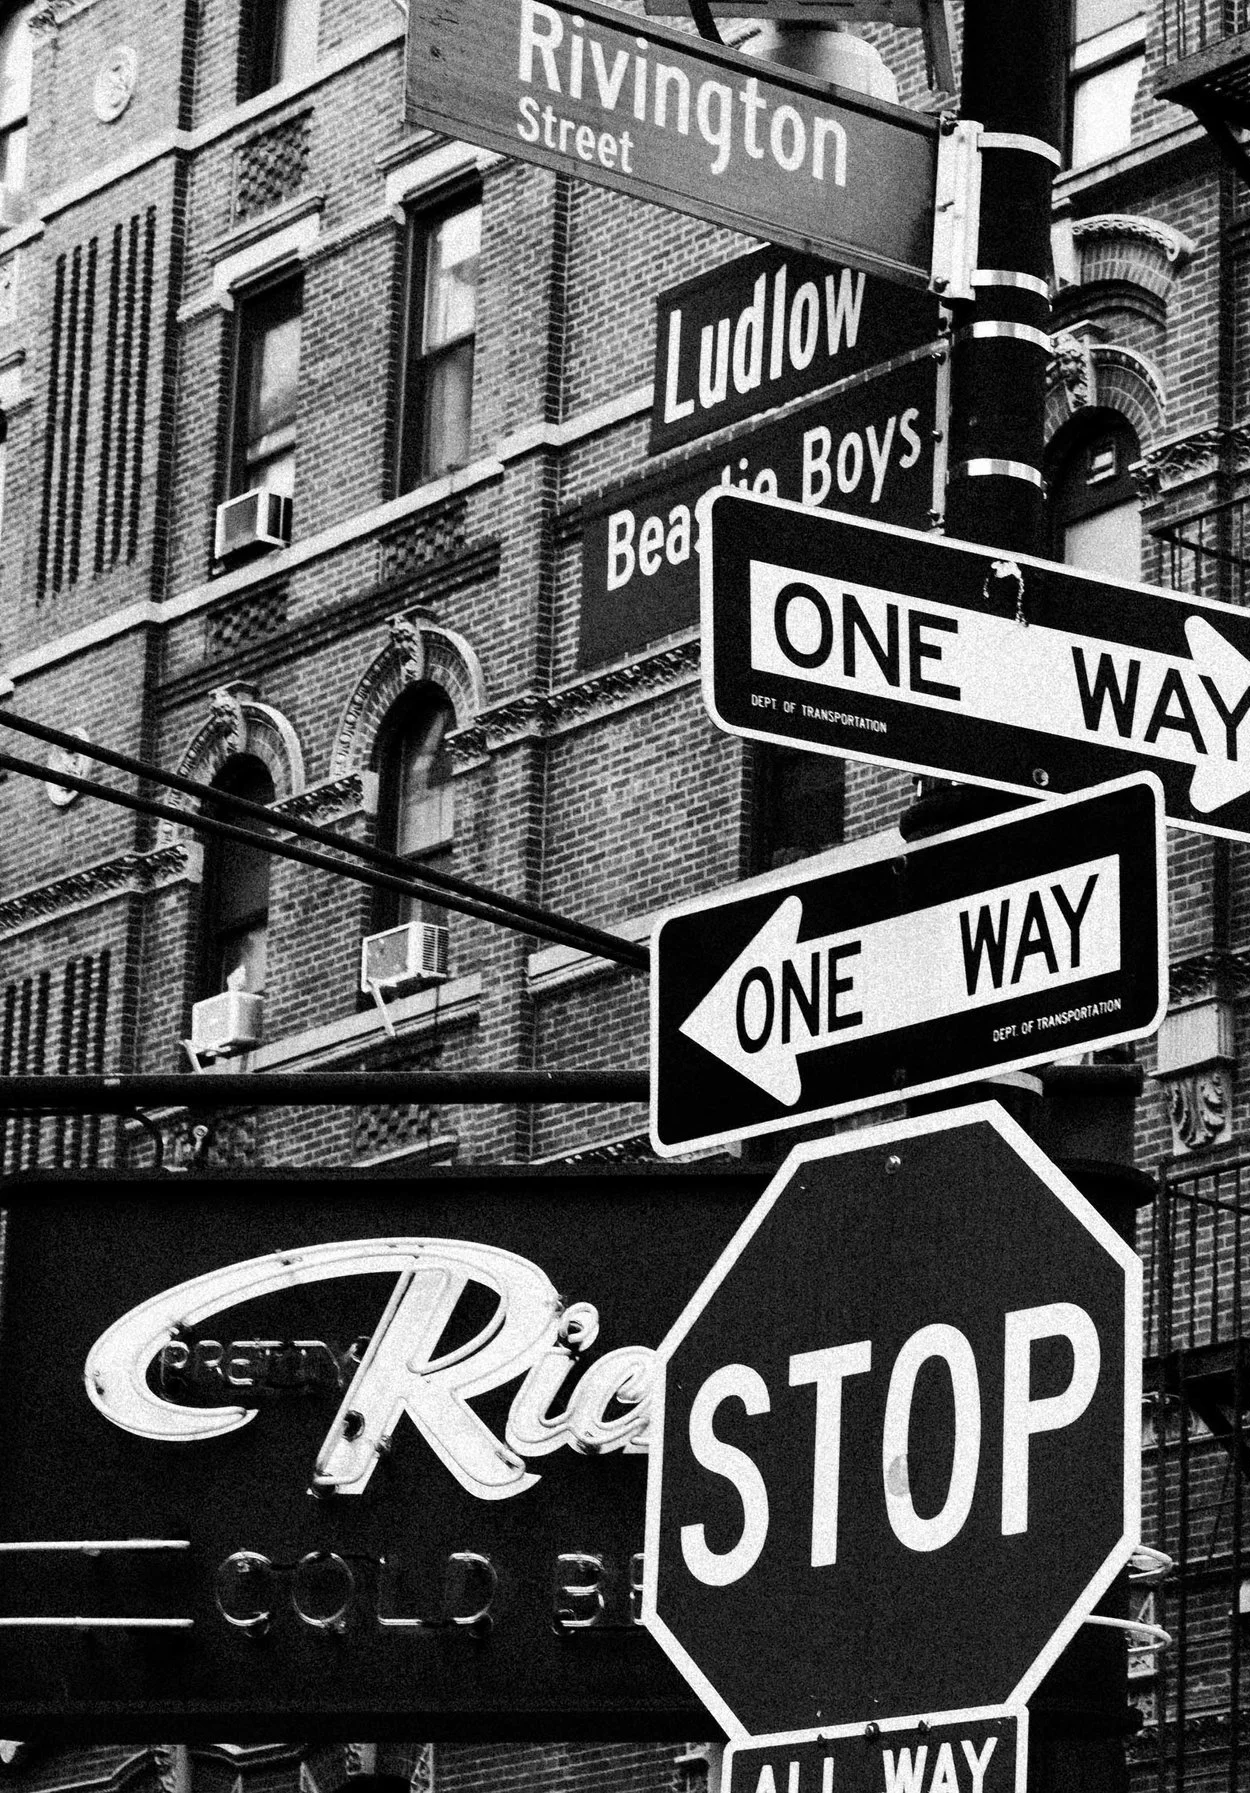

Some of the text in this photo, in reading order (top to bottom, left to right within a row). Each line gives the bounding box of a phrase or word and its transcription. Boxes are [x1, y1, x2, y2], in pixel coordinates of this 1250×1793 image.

[517, 97, 634, 174] Street
[518, 0, 848, 188] Rivington
[663, 264, 866, 425] Ludlow
[801, 407, 922, 506] Boys
[773, 581, 961, 702] ONE
[783, 700, 797, 714] OF
[801, 703, 888, 734] TRANSPORTATION
[735, 873, 1100, 1054] ONE WAY
[1021, 1020, 1035, 1035] OF
[1036, 998, 1122, 1031] TRANSPORTATION
[680, 1301, 1101, 1587] STOP
[215, 1549, 499, 1628] COLD
[882, 1736, 999, 1793] WAY
